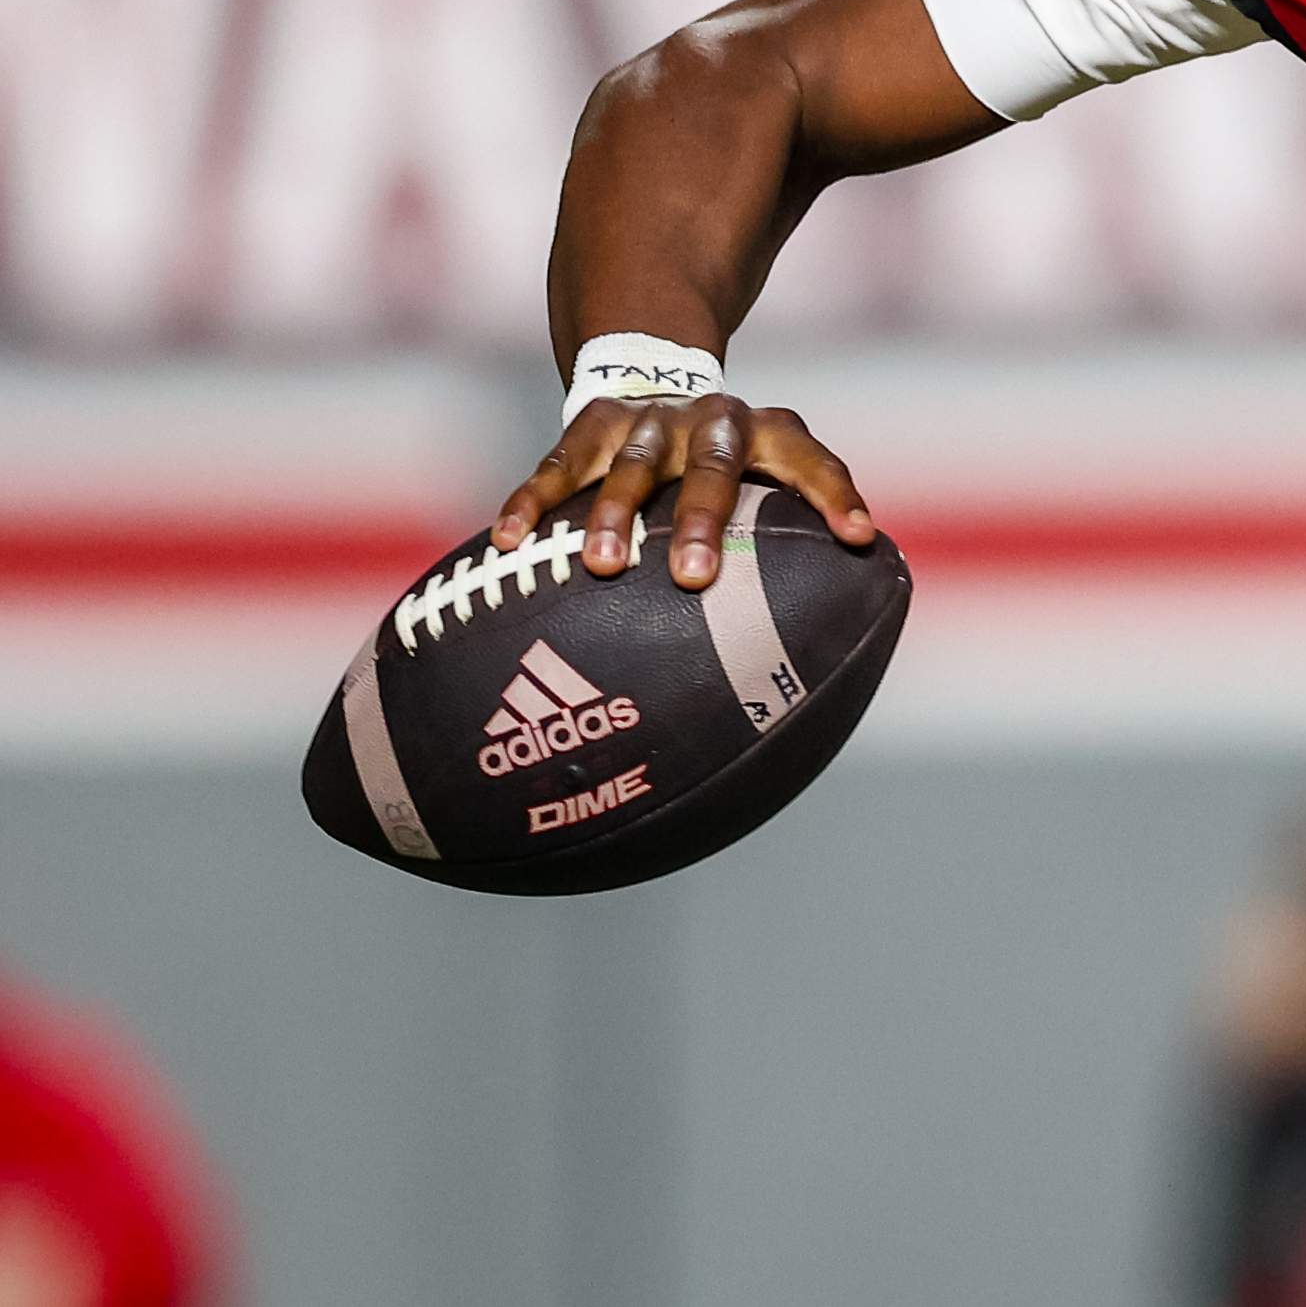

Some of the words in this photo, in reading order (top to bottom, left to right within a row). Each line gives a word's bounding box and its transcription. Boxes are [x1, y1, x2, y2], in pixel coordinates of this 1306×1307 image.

[588, 365, 715, 394] TAKE
[478, 697, 642, 777] adidas
[527, 764, 653, 834] DIME
